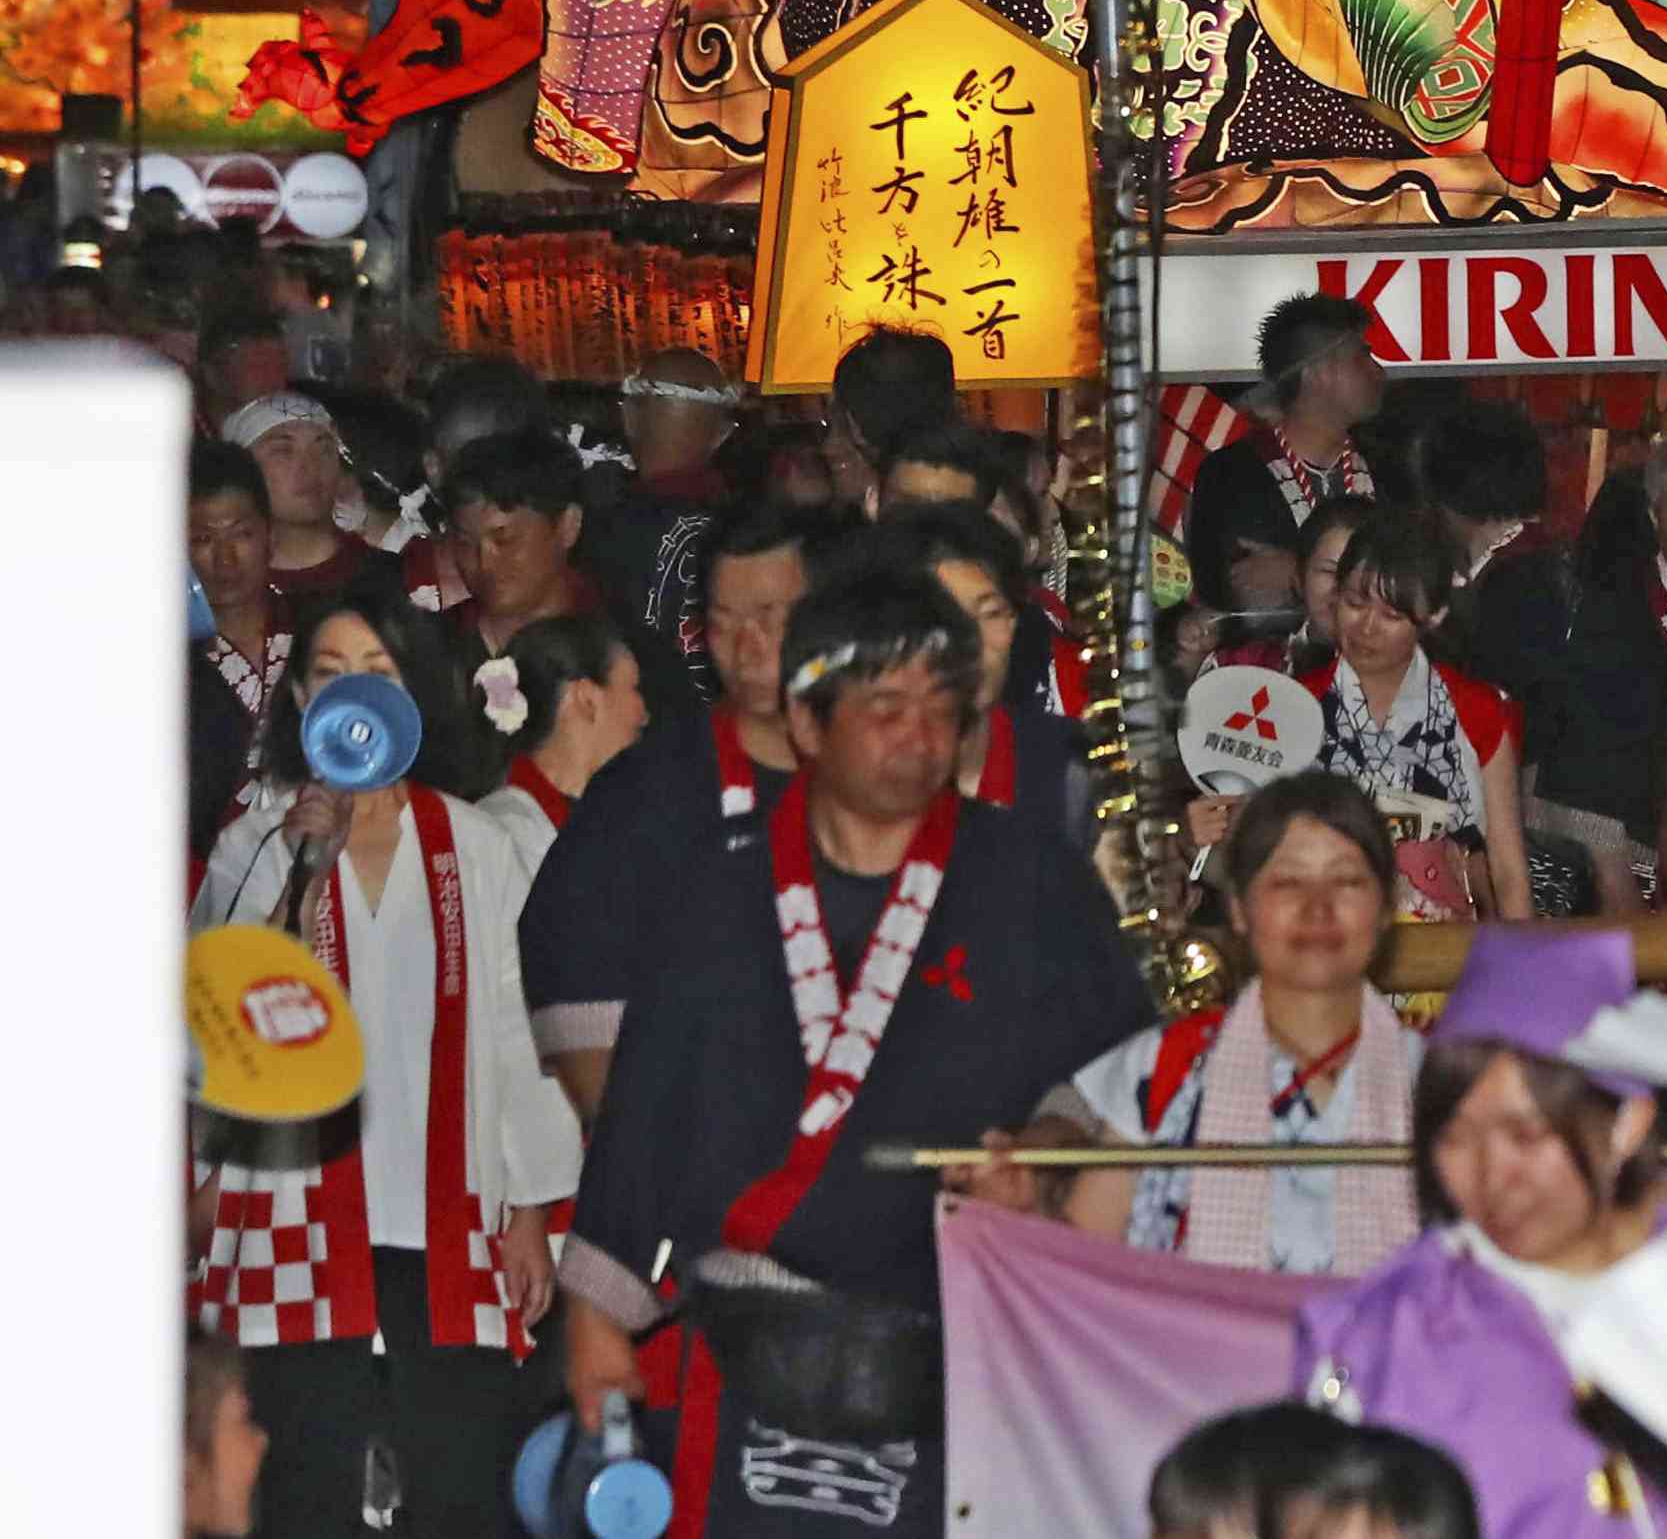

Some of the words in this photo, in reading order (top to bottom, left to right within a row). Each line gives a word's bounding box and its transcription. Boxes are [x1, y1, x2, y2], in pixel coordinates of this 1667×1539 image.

[948, 64, 1036, 360] 紀朝雄の一首
[1203, 731, 1285, 769] 青森菱友会
